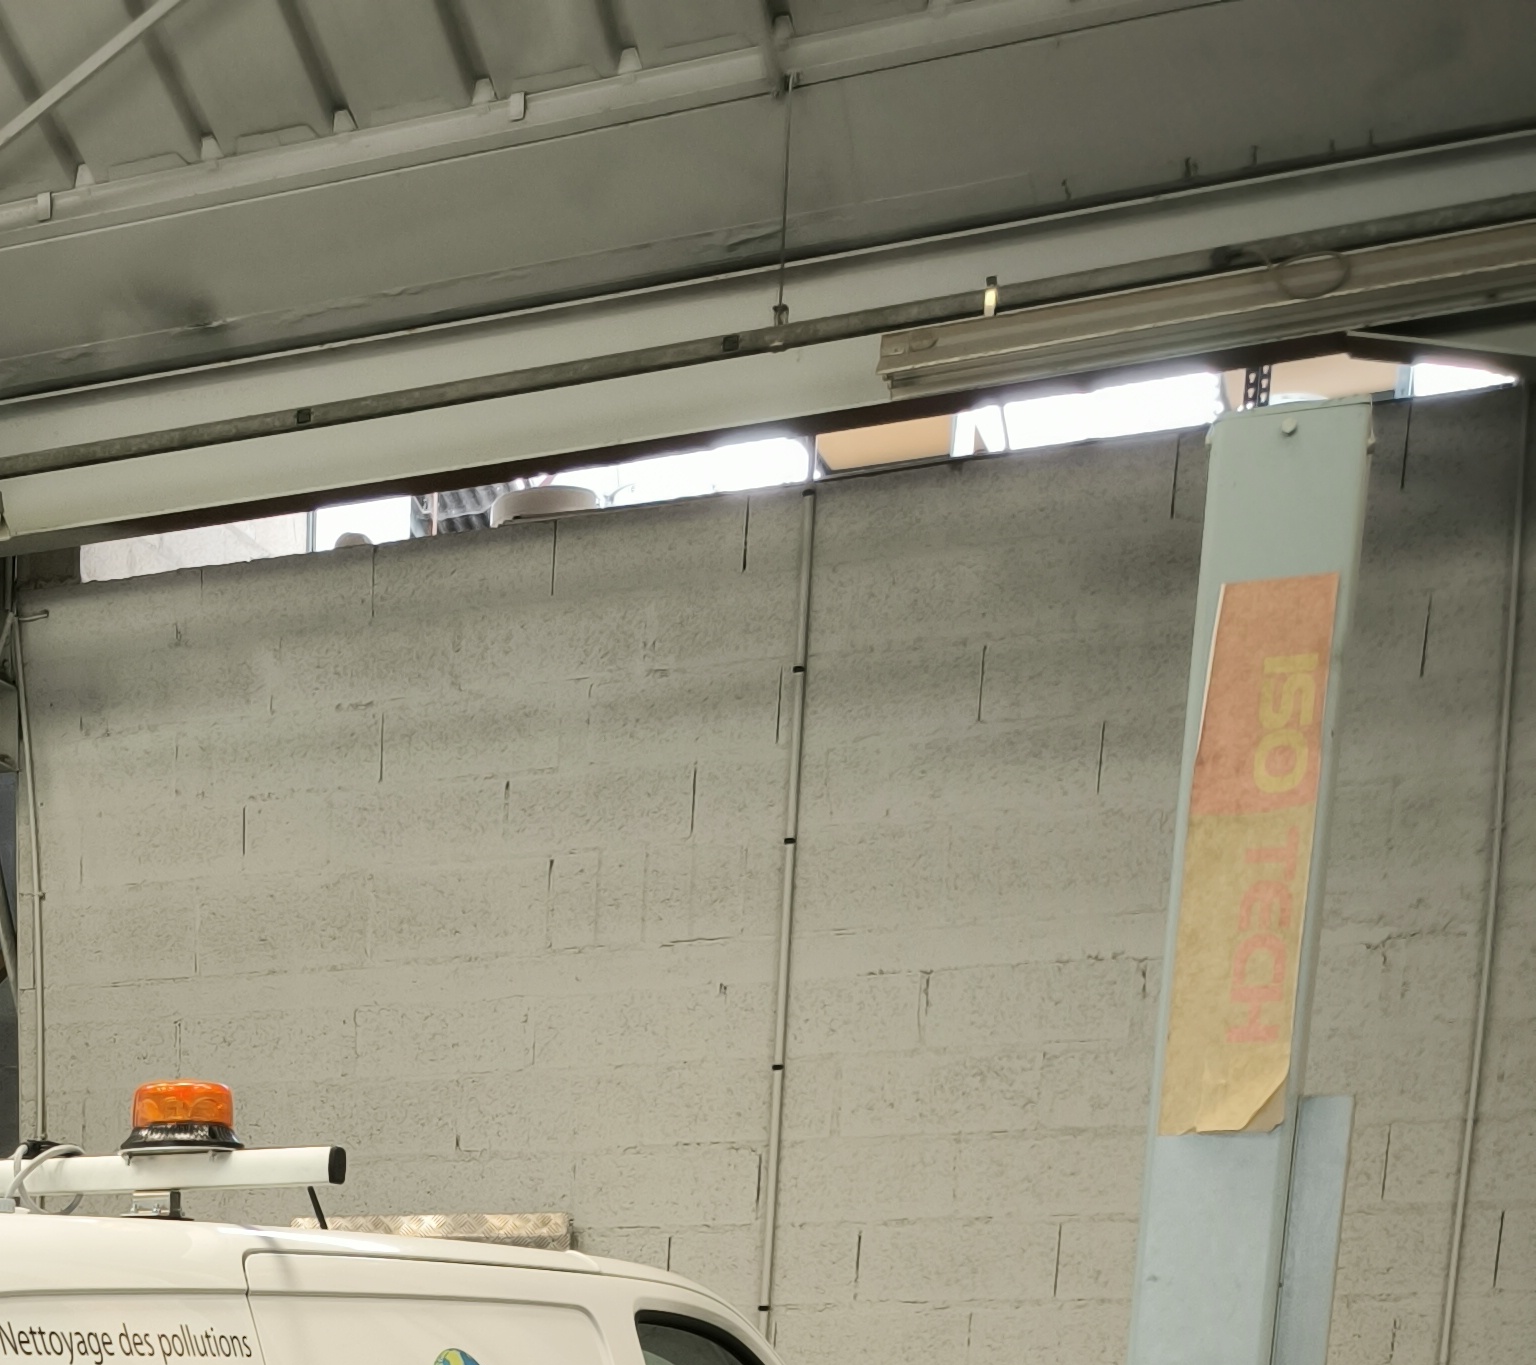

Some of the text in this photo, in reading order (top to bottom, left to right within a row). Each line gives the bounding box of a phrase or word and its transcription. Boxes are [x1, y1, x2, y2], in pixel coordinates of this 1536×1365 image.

[1225, 652, 1319, 1045] ISO TECH
[119, 1323, 155, 1356] des
[157, 1325, 252, 1365] pollutions
